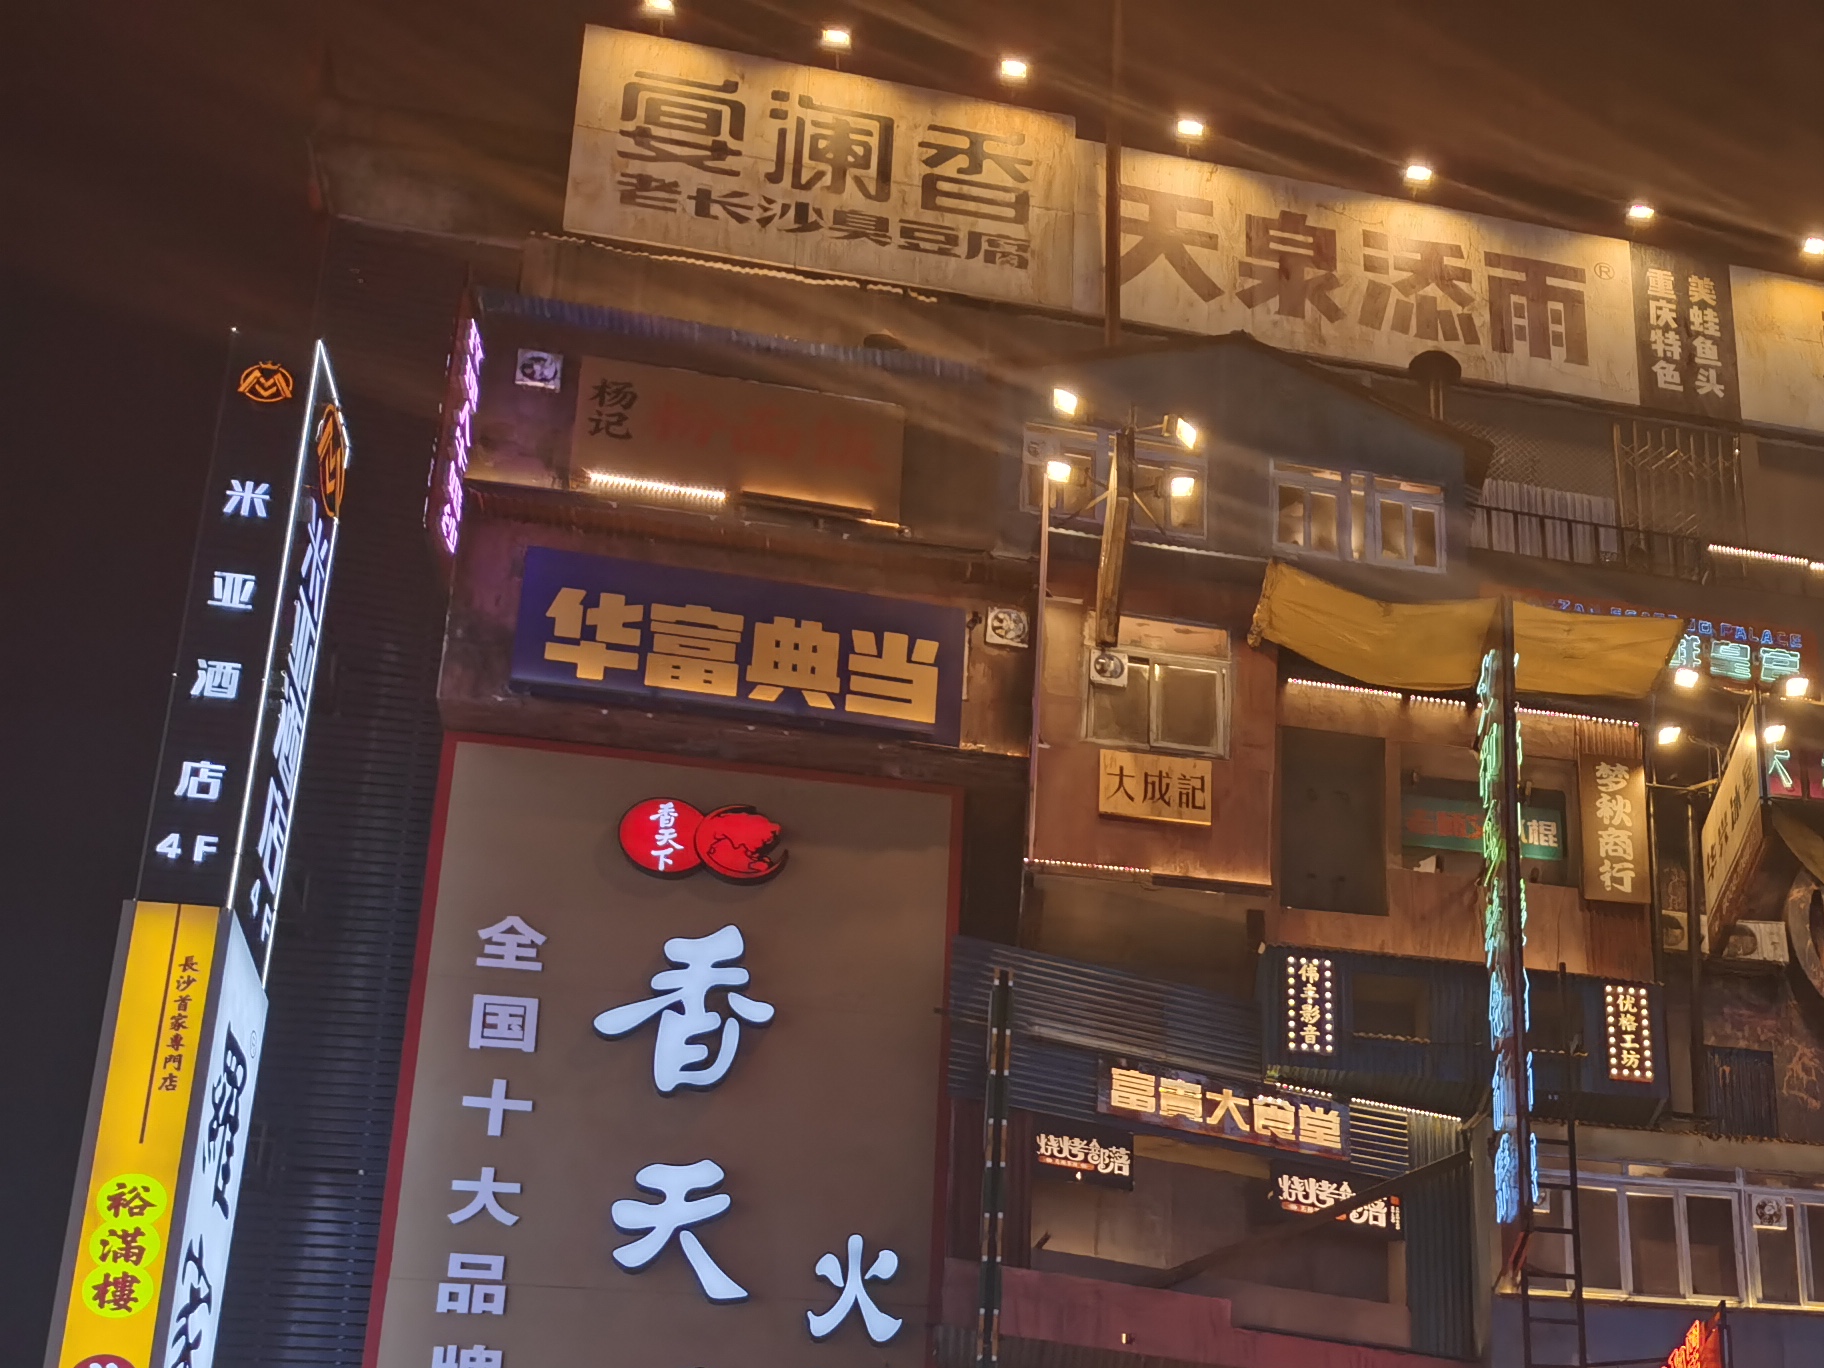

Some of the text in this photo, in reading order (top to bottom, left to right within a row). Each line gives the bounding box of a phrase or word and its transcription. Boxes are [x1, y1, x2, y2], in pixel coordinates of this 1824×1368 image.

[616, 70, 1032, 226] 宴澜香
[618, 171, 1030, 270] 老长沙臭豆腐
[1118, 186, 1590, 366] 天泉添雨
[1645, 266, 1685, 394] 重庆特色
[1687, 275, 1726, 399] 美蛙鱼头
[588, 377, 638, 441] 杨记
[174, 478, 271, 801] 米亚酒店
[544, 587, 940, 724] 华富典当
[650, 801, 684, 872] 香天下
[1106, 765, 1207, 811] 大成記
[1595, 762, 1635, 893] 梦秋商行
[157, 954, 200, 1093] 長沙首家專門店
[1616, 994, 1641, 1069] 优格工坊
